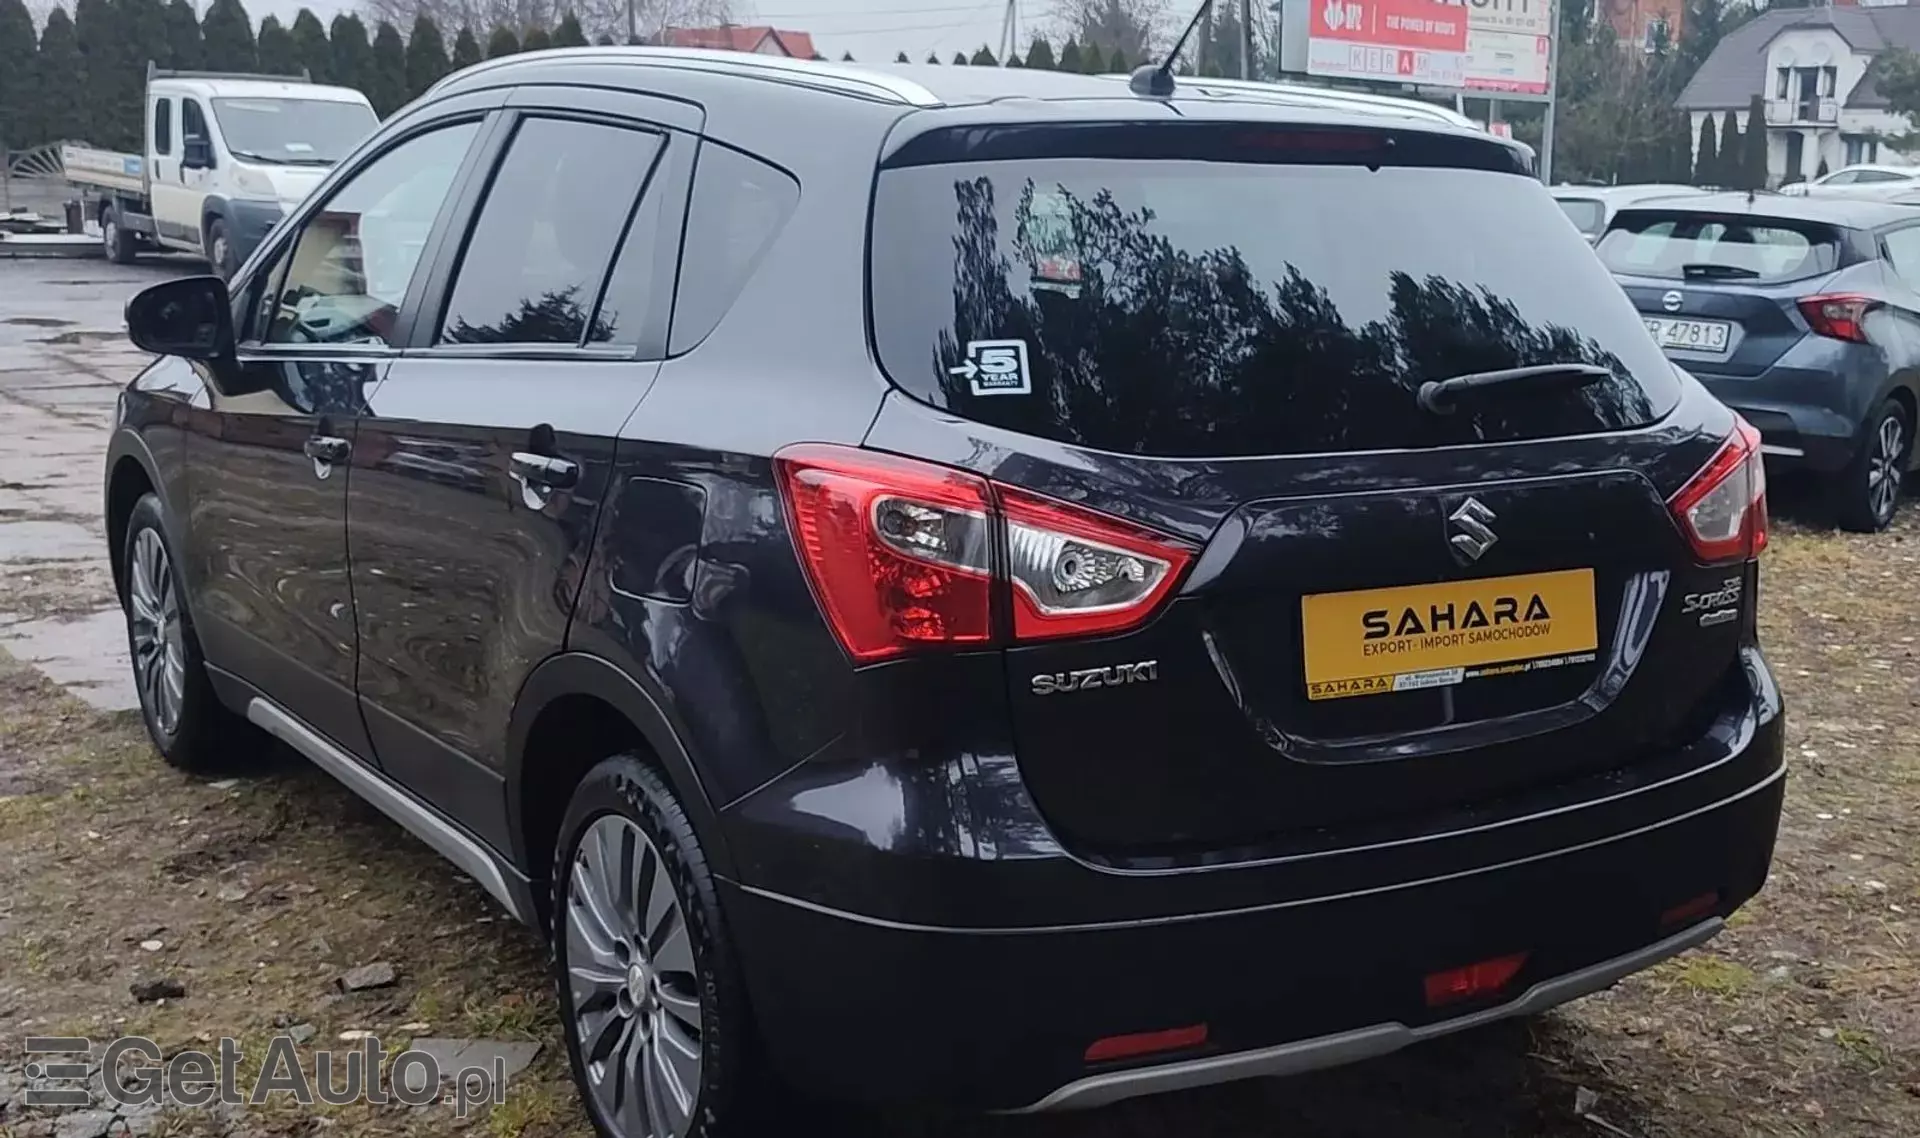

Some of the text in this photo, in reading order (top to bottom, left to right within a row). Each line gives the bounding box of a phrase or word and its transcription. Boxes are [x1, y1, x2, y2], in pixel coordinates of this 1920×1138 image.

[1666, 321, 1725, 345] 47813
[979, 349, 1018, 373] 5
[981, 373, 1018, 382] YEAR
[1362, 593, 1551, 640] SAHARA
[1420, 633, 1465, 649] IMPORT
[1468, 623, 1551, 645] SAMOCHODÓW
[1031, 660, 1158, 695] SUZUKI
[1311, 677, 1388, 694] SAHARA
